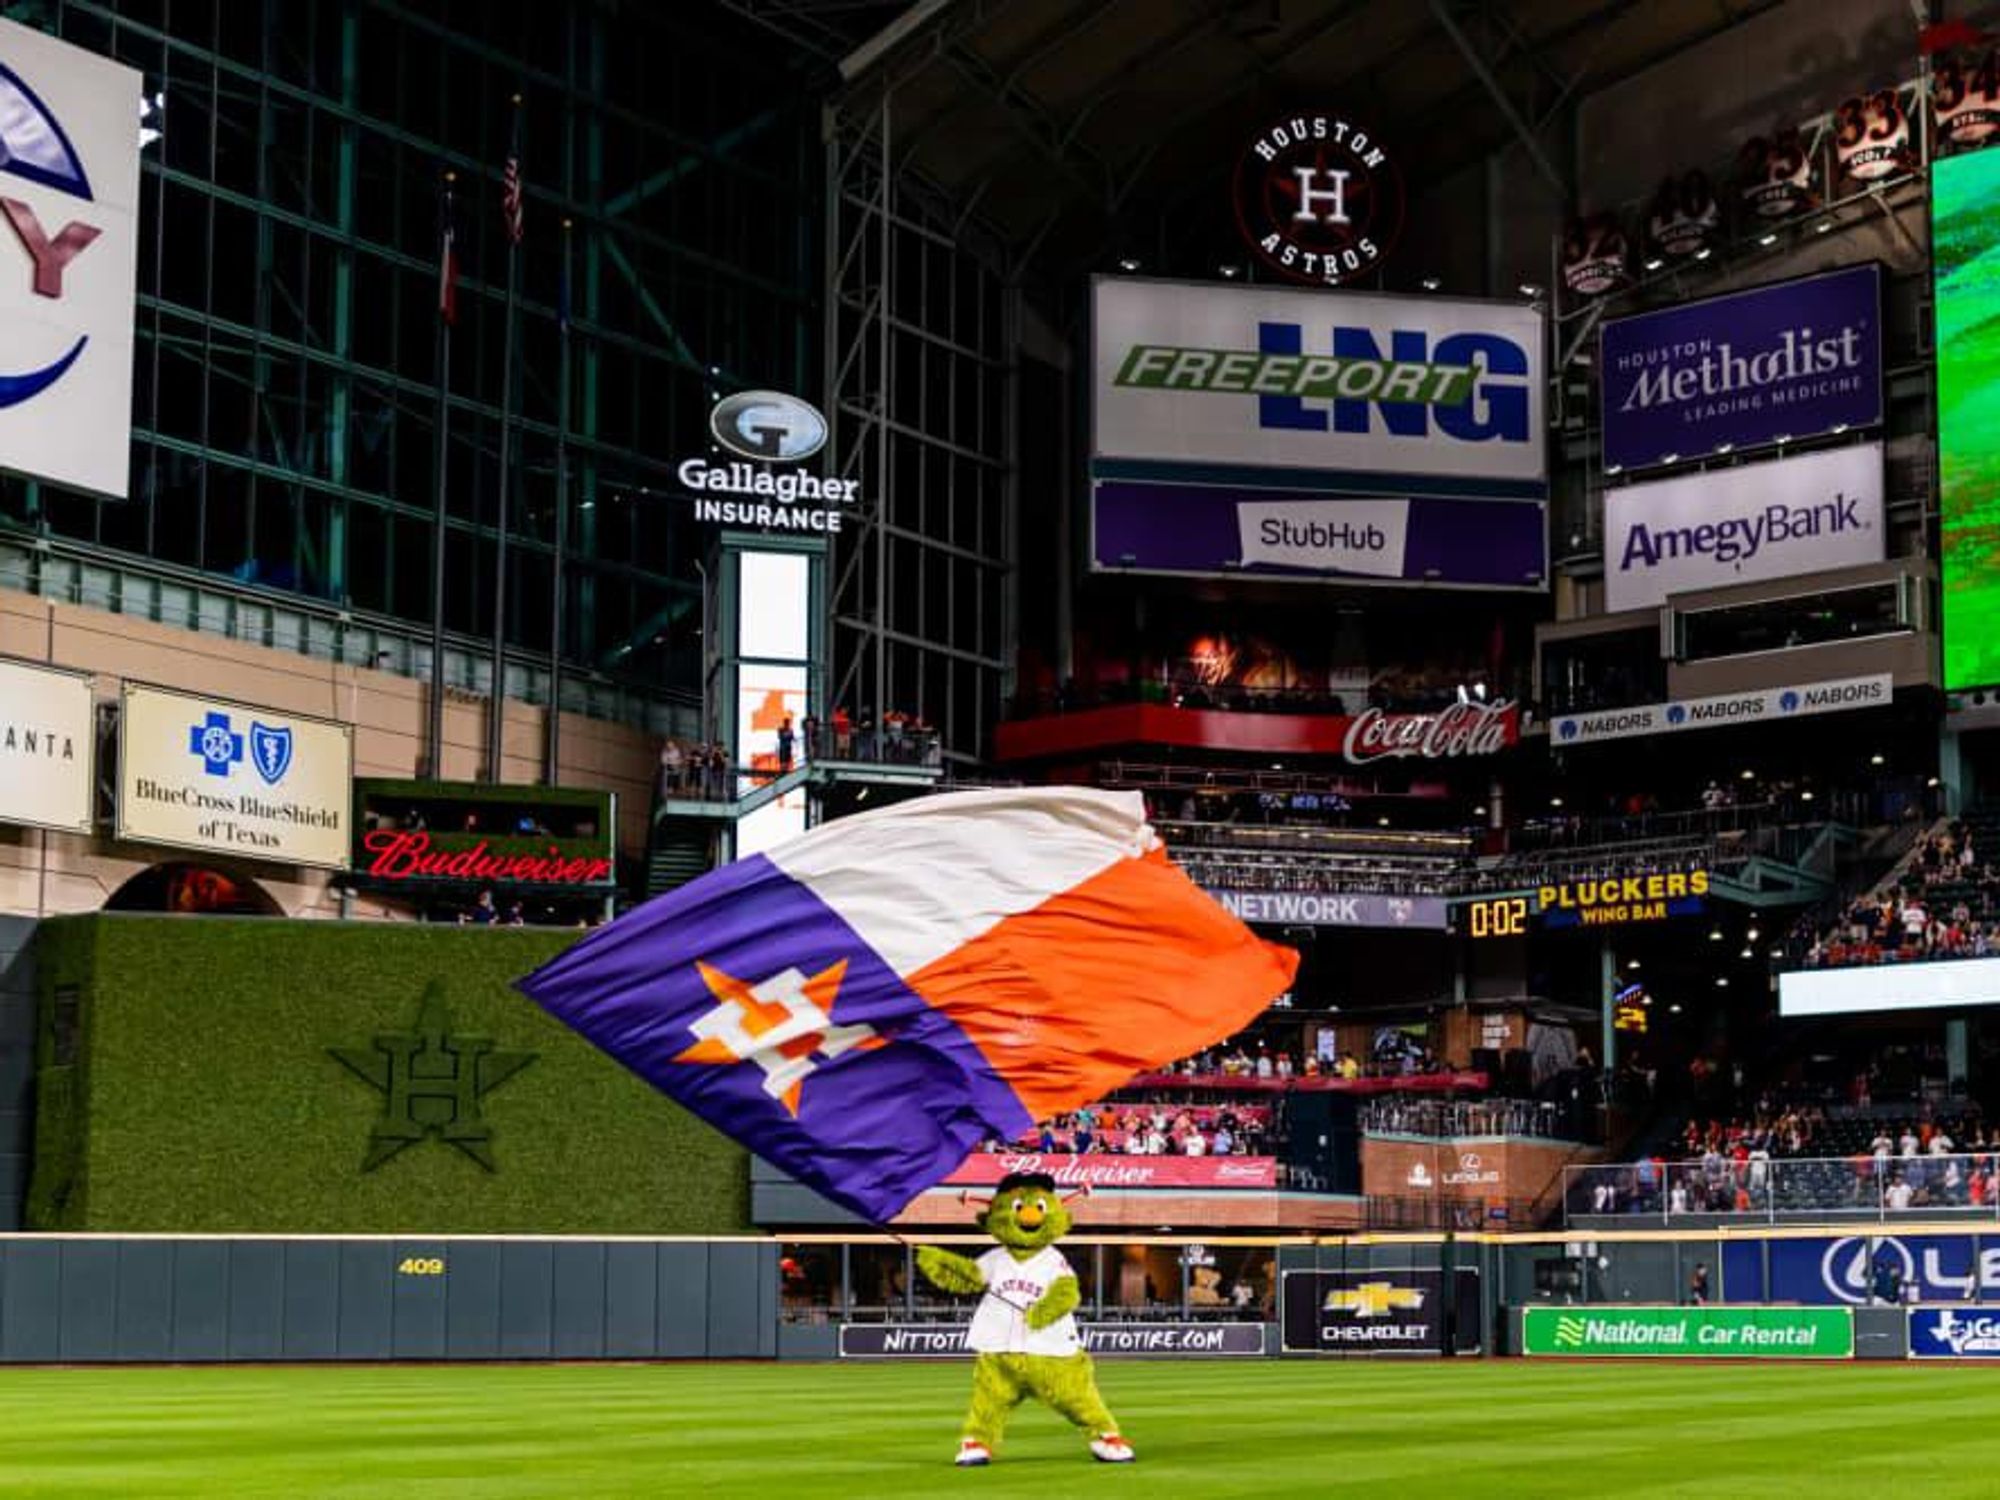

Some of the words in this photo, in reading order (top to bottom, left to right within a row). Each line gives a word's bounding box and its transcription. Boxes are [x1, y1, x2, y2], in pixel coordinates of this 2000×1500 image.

[1836, 89, 1900, 147] 33
[1253, 117, 1386, 169] HOUSTON
[1292, 166, 1351, 224] H
[1260, 233, 1379, 275] ASTROS
[1127, 347, 1469, 401] FREEPORT
[1617, 338, 1714, 371] HOUSTON
[1619, 326, 1862, 412] Methodist
[1259, 320, 1530, 443] LNG
[1684, 395, 1763, 423] LEADING
[1772, 375, 1862, 406] MEDICINE
[678, 459, 860, 504] Gallagher
[695, 500, 842, 532] INSURANCE
[1260, 518, 1385, 551] StubHub
[1619, 493, 1862, 572] AmegyBank
[1580, 712, 1653, 735] NABORS
[1690, 698, 1766, 722] NABORS
[1804, 682, 1883, 706] NABORS
[5, 725, 74, 760] ANTA
[135, 778, 236, 815] BlueCross
[239, 795, 339, 830] BlueShield
[198, 819, 219, 838] of
[221, 820, 282, 848] Texas
[364, 828, 611, 882] Budweiser
[1221, 889, 1360, 921] NETWORK
[1539, 870, 1710, 910] PLUCKERS
[1471, 898, 1526, 938] 0:02
[1581, 905, 1628, 924] WING
[1632, 902, 1667, 920] BAR
[398, 1258, 444, 1274] 409
[1322, 1324, 1430, 1341] CHEVROLET
[1584, 1318, 1684, 1345] National
[1697, 1325, 1735, 1345] Car
[1739, 1325, 1818, 1346] Rental
